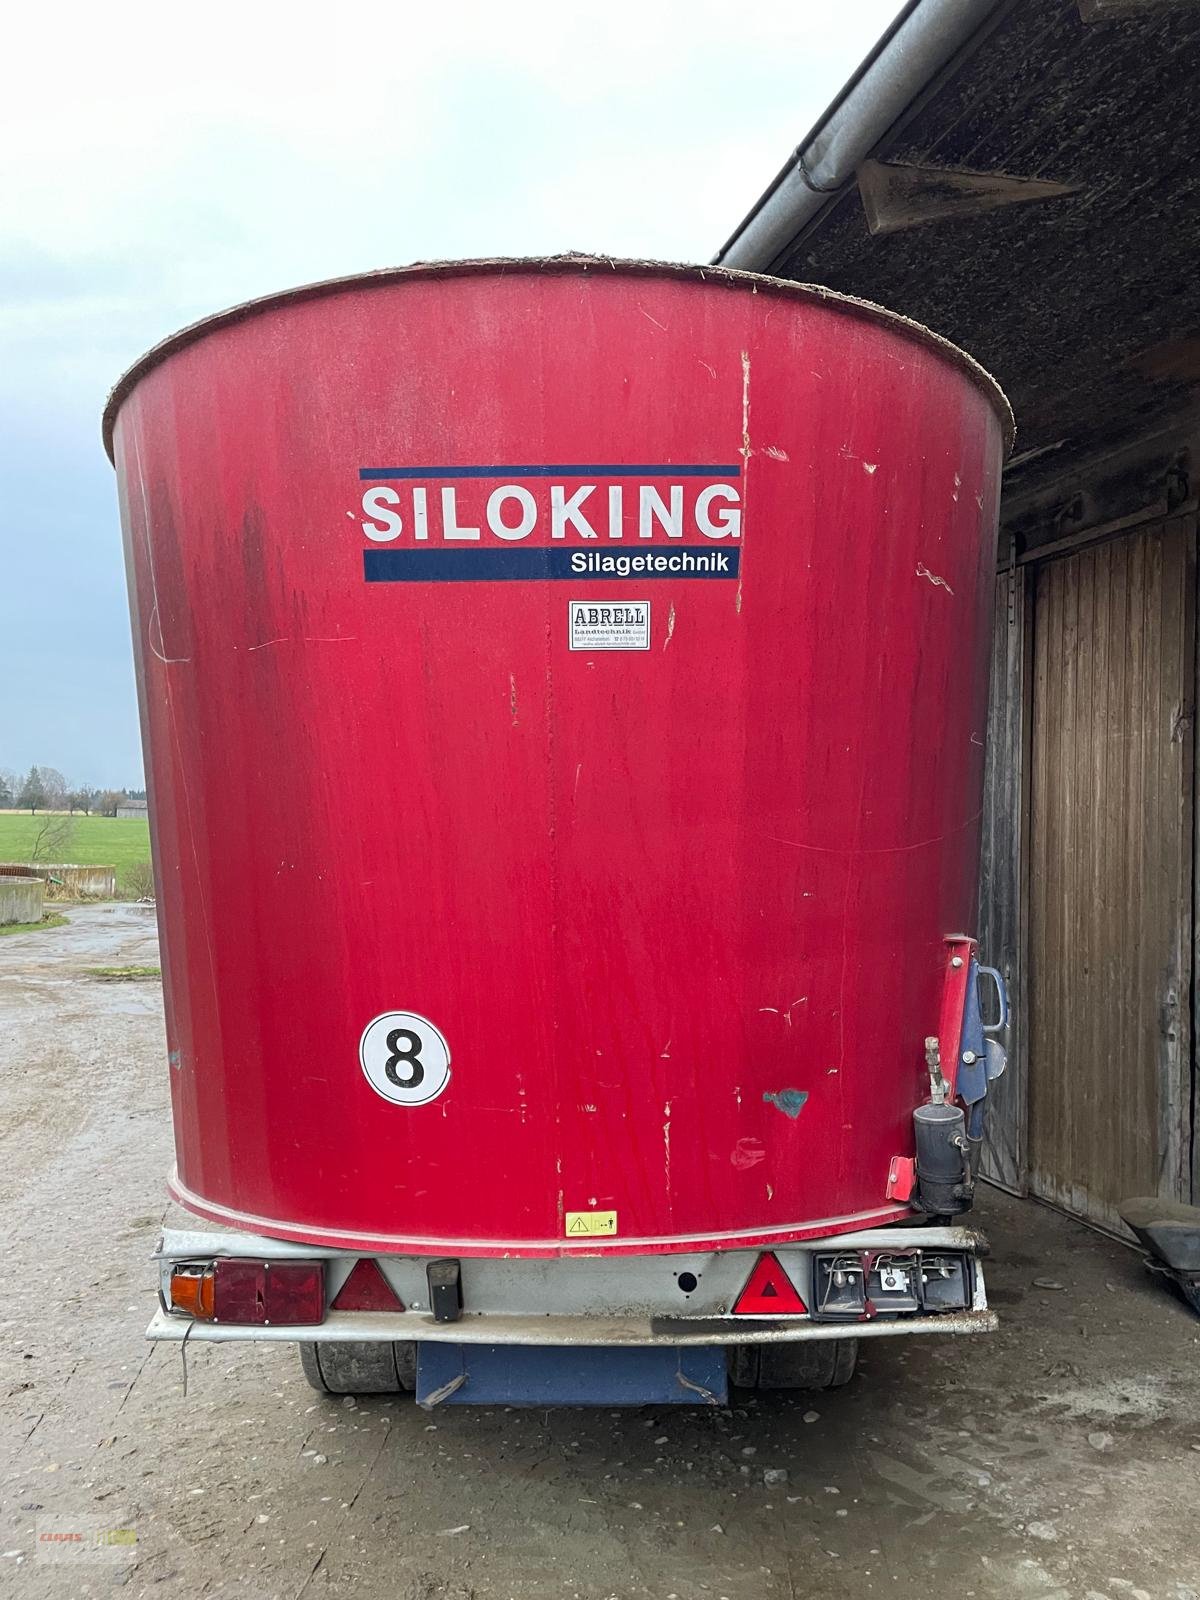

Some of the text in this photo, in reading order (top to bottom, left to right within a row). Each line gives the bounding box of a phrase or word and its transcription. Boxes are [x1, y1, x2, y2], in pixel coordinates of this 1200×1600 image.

[361, 484, 742, 542] SILOKING
[571, 552, 729, 576] Silagetechnik
[574, 608, 645, 626] ABRELL
[384, 1028, 425, 1089] 8
